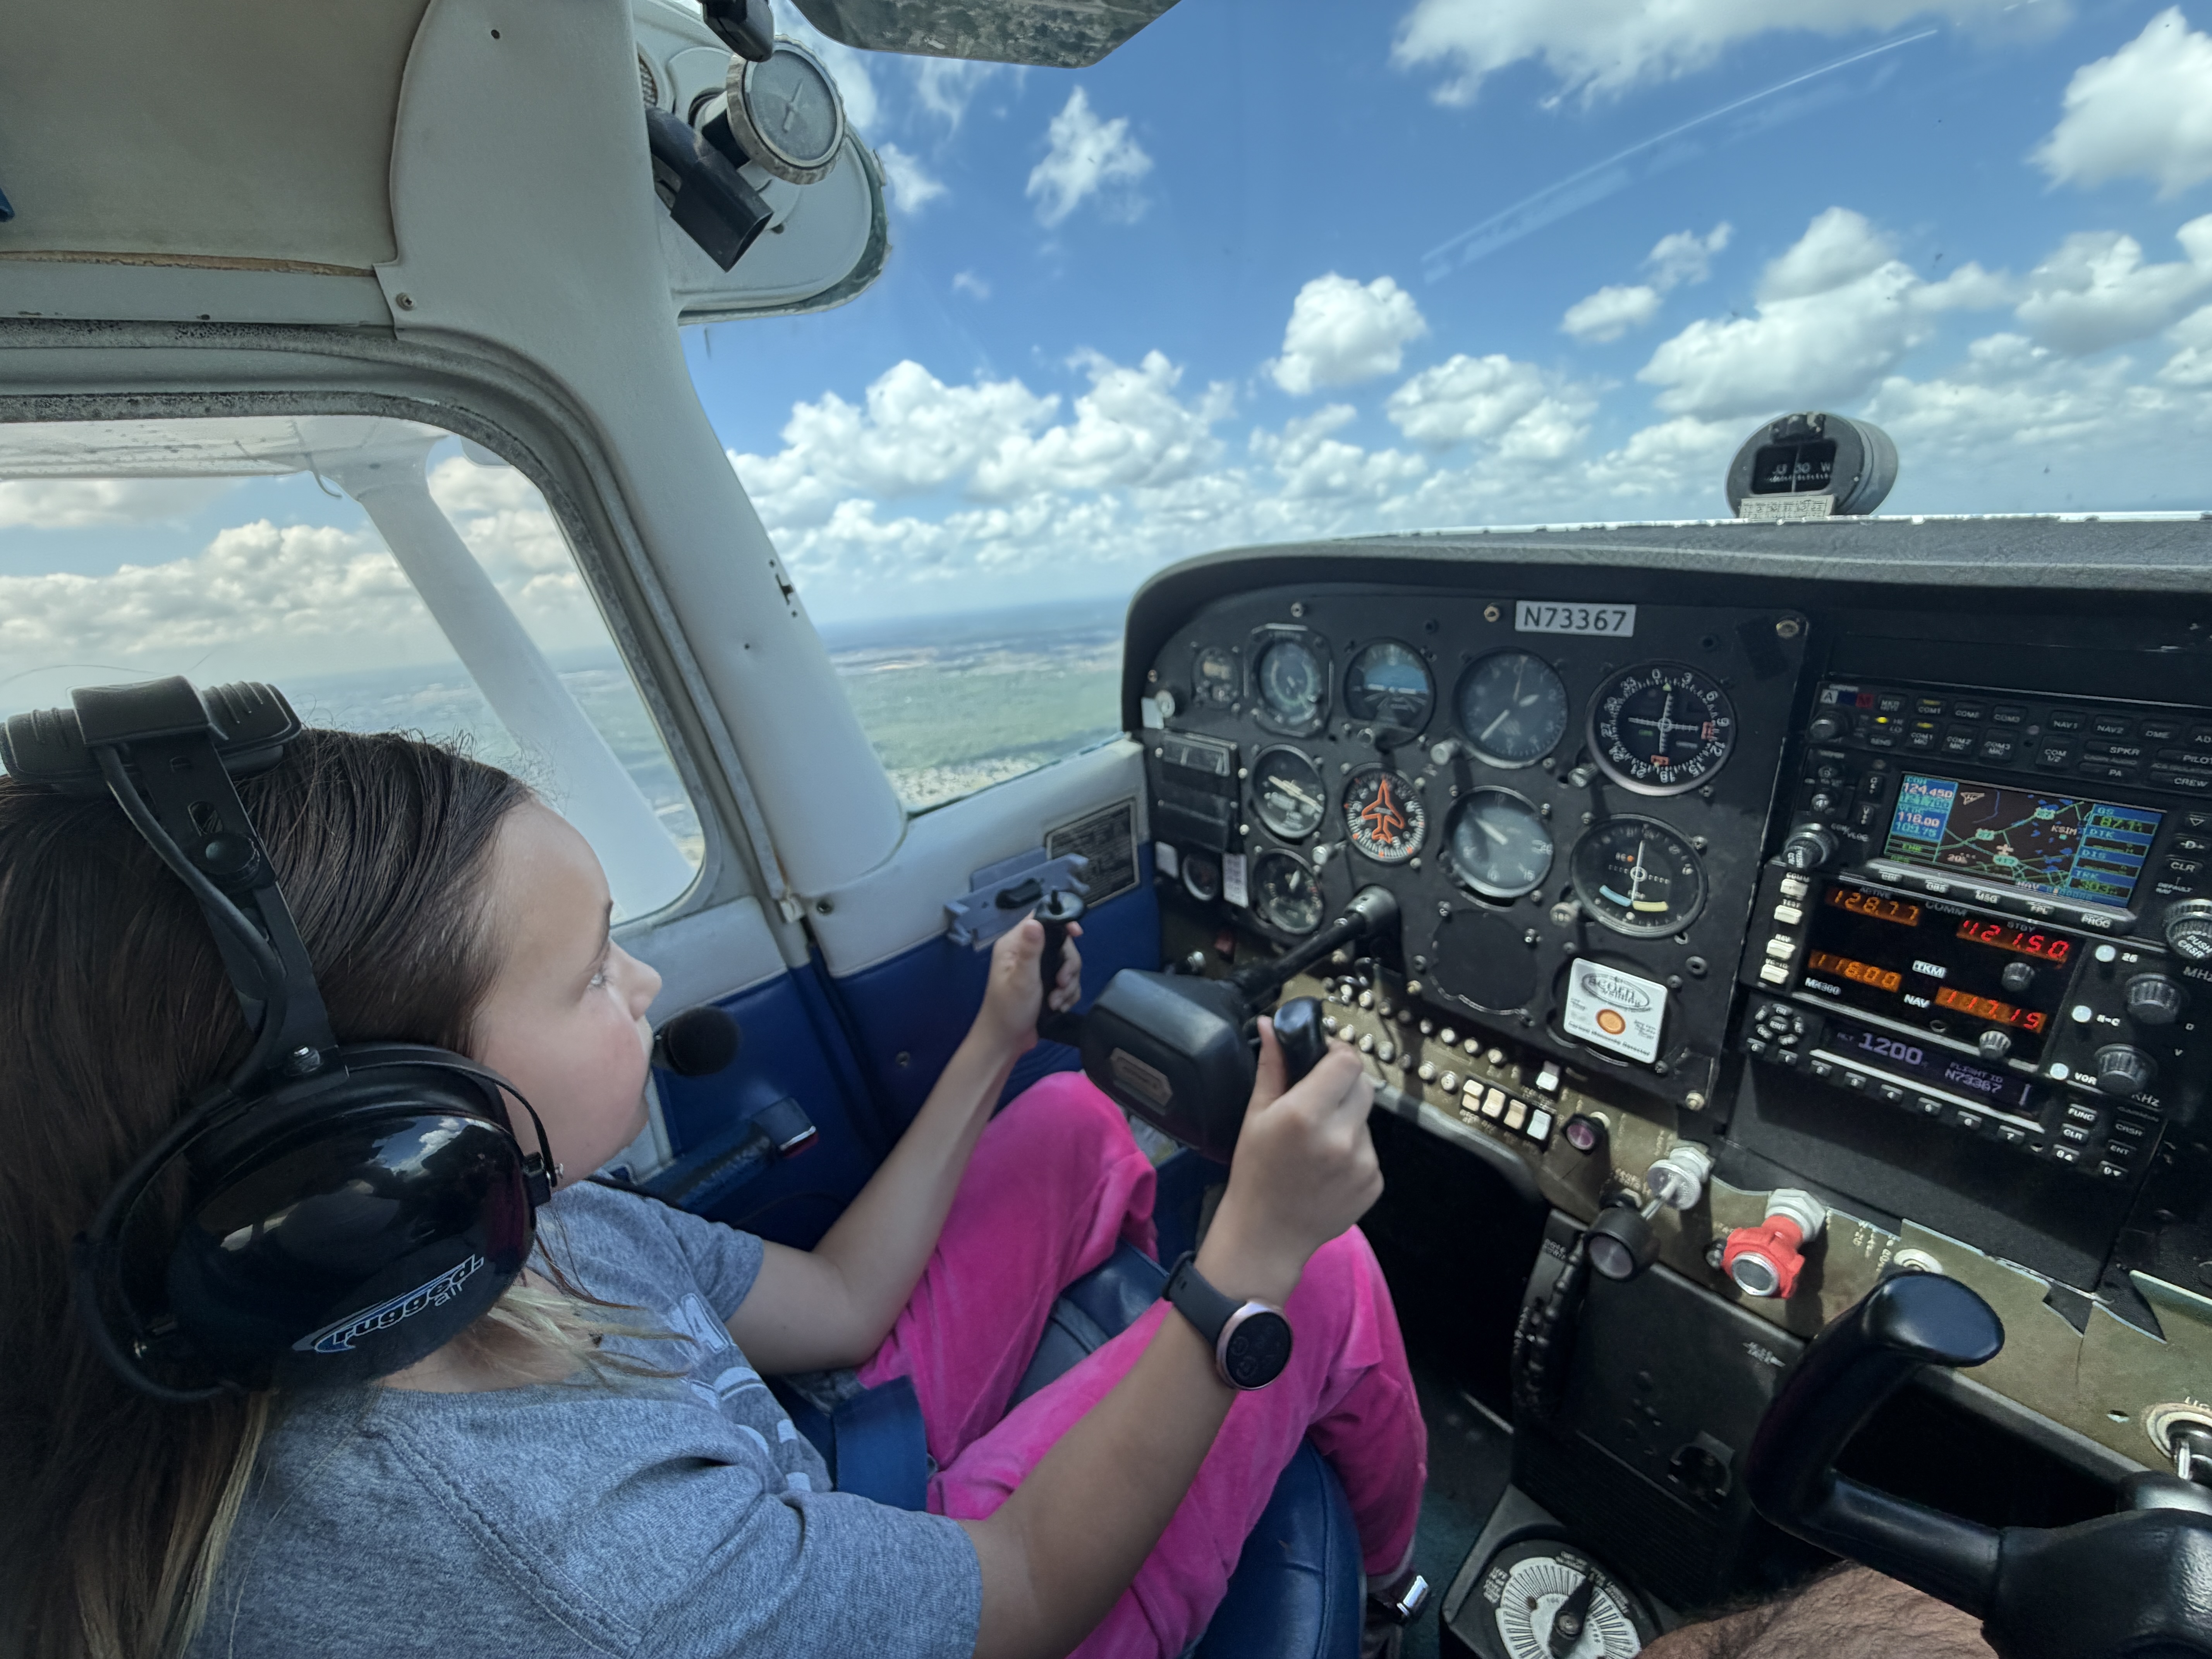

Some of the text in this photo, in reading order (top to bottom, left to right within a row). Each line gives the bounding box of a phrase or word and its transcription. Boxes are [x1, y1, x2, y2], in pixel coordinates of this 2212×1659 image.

[1524, 606, 1626, 631] N73367
[1652, 668, 1661, 680] 0
[1682, 672, 1692, 684] 3
[1706, 691, 1718, 702] 6
[1918, 706, 1941, 715] COM1
[1717, 717, 1729, 727] 9
[2053, 720, 2078, 730] NAV1
[2097, 725, 2124, 734] NAV2
[1946, 735, 1972, 745] COM2
[1984, 740, 2011, 750] COM3
[2195, 735, 2212, 744] AD
[1710, 741, 1726, 756] 12
[2044, 748, 2068, 757] COM
[2109, 746, 2141, 756] SPKR
[1688, 761, 1705, 777] 15
[2108, 769, 2123, 777] PA
[1659, 771, 1676, 783] 18
[2173, 777, 2209, 787] CREW
[1903, 782, 1953, 799] 124.450
[1898, 811, 1940, 828] 118.00
[2170, 861, 2195, 872] CLR
[1786, 872, 1810, 883] COMM
[1860, 887, 1892, 899] ACTIVE
[1925, 901, 1968, 917] COMM
[2030, 905, 2049, 915] FPL
[1903, 994, 1930, 1008] NAV
[1858, 1032, 1924, 1065] 1200
[2074, 1072, 2098, 1085] VOR
[2067, 1107, 2095, 1122] FUNC
[2110, 1145, 2130, 1156] ENT
